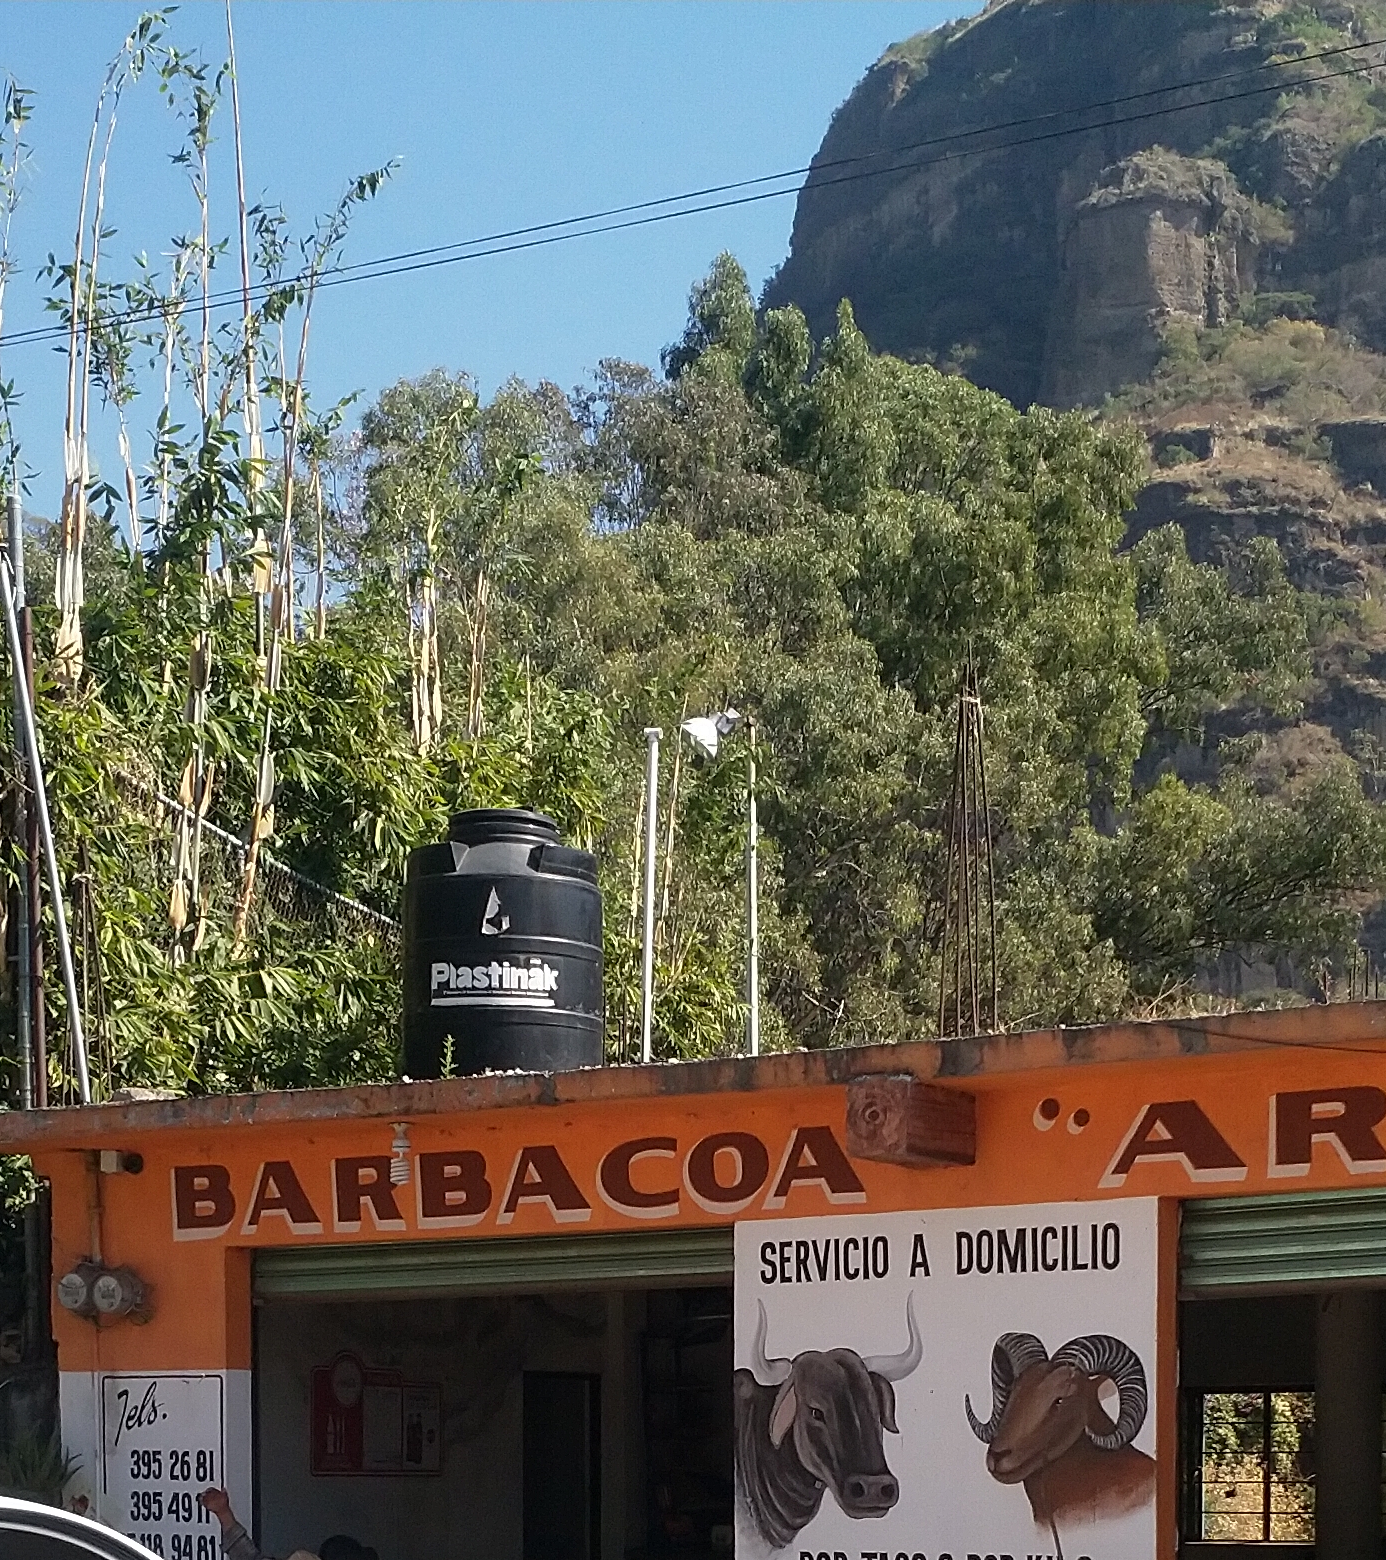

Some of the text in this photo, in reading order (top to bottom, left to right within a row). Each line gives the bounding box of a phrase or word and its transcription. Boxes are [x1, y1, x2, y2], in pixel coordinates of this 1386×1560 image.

[172, 1125, 866, 1241] BARBACOA
[759, 1223, 1121, 1285] SERVICIO A DOMICILIO
[115, 1381, 168, 1446] Tels.
[130, 1450, 162, 1479] 395
[130, 1491, 163, 1521] 395
